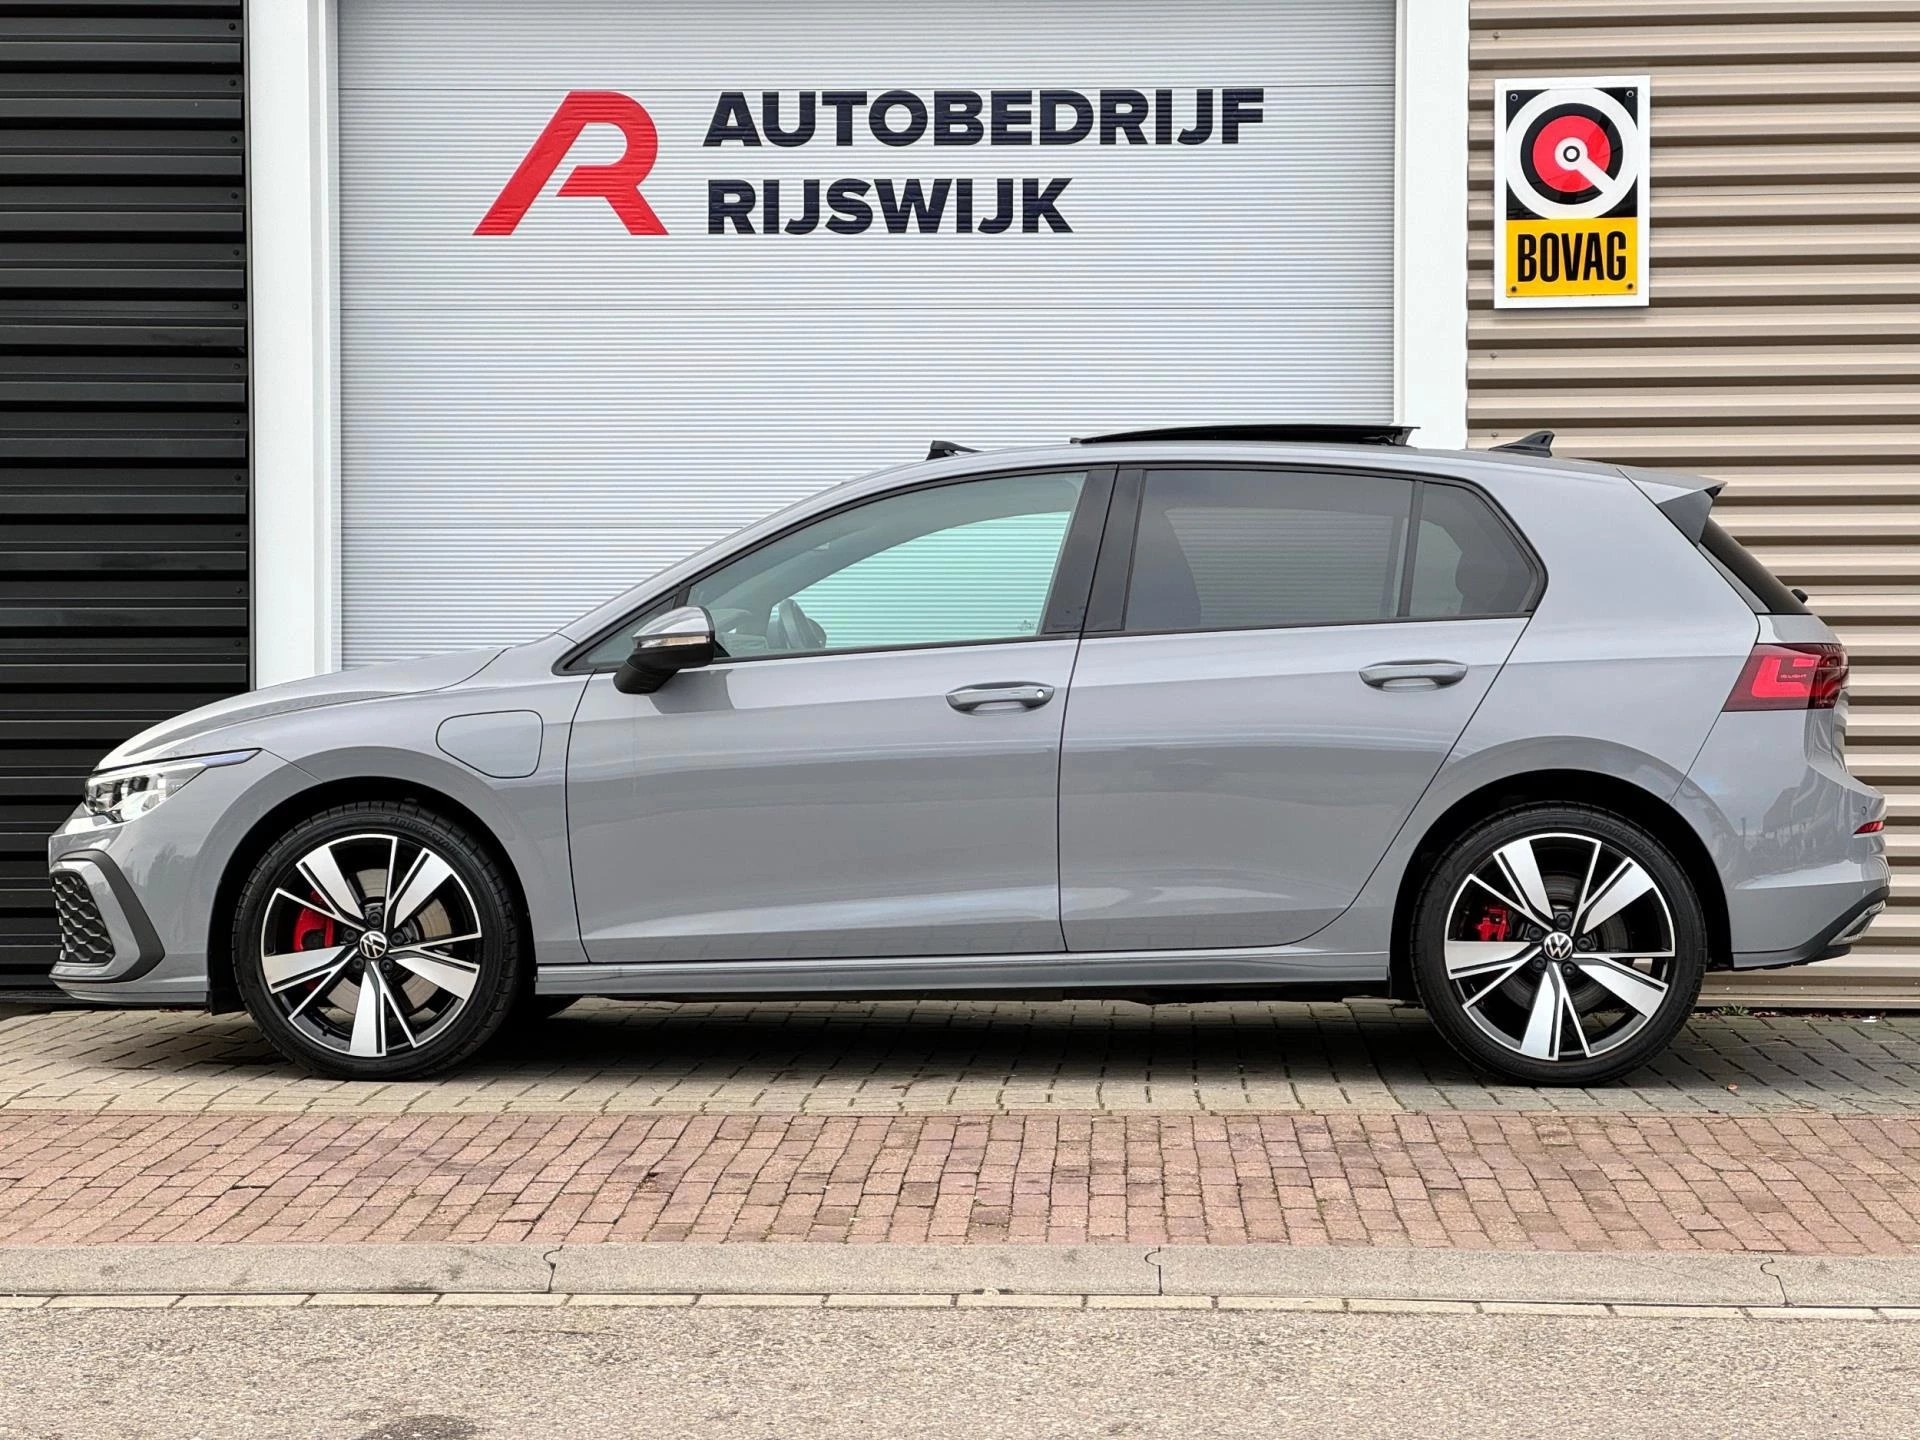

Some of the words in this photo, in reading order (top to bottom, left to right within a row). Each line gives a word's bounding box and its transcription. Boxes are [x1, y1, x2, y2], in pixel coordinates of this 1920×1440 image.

[704, 88, 1265, 147] AUTOBEDRIJF
[709, 178, 1074, 235] RIJSWIJK
[1519, 232, 1627, 282] BOVAG
